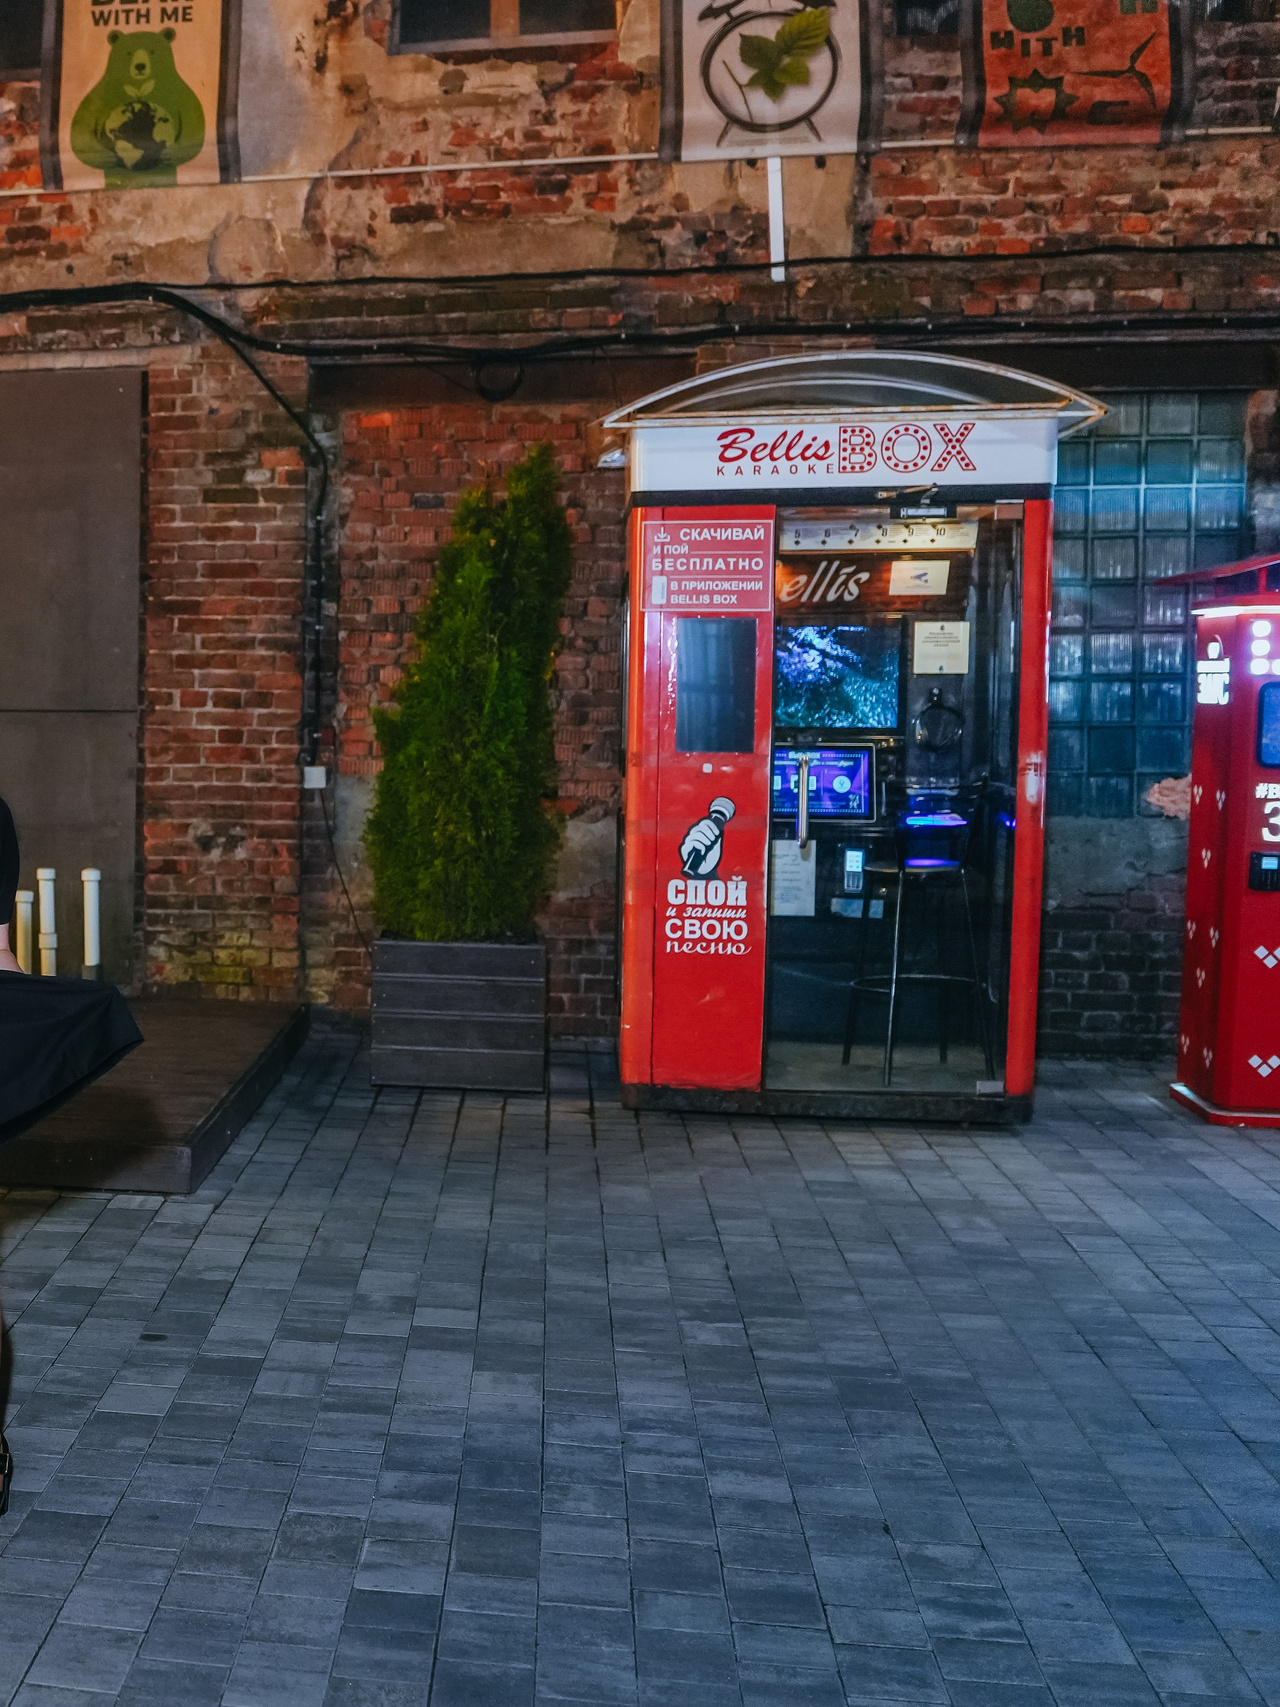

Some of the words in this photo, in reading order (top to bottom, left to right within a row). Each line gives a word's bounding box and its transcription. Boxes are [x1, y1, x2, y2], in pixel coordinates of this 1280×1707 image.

[91, 8, 150, 27] WITH
[160, 6, 193, 23] ME
[990, 26, 1086, 58] WITH
[717, 428, 835, 463] Bellis
[838, 423, 976, 473] BOX
[717, 463, 834, 476] KARAOKE
[680, 525, 765, 540] СКАЧИВАЙ
[935, 527, 946, 536] 10
[653, 545, 661, 554] И
[664, 543, 689, 554] ПОЙ
[652, 558, 763, 570] БЕСПЛАТНО
[671, 581, 678, 591] В
[682, 581, 763, 590] ПРИЛОЖЕНИИ
[776, 560, 871, 602] ellis
[671, 595, 710, 604] BELLIS
[713, 594, 738, 604] BOX
[667, 875, 747, 906] СПОЙ
[666, 907, 677, 917] и
[683, 907, 747, 918] запиши
[665, 918, 748, 940] СВОЮ
[666, 941, 752, 955] песню
